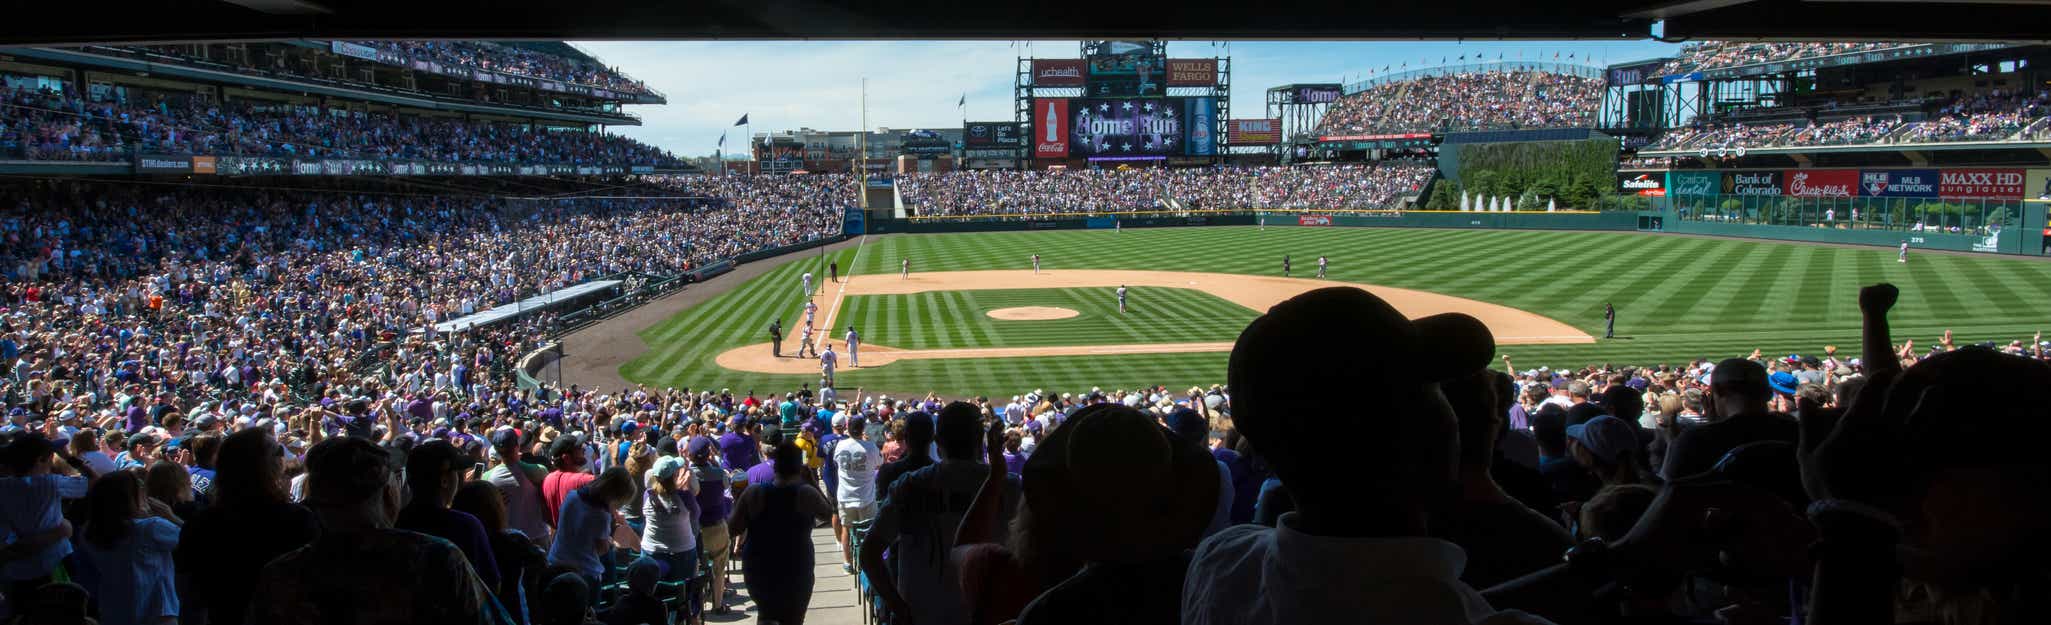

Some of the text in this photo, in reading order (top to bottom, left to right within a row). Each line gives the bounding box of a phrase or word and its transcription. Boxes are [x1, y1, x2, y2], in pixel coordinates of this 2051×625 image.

[1040, 66, 1080, 77] uchealth
[1172, 63, 1211, 72] WELLS
[1173, 72, 1211, 81] FARGO
[1610, 69, 1640, 85] Run
[1076, 115, 1178, 136] Home Run
[1623, 179, 1660, 189] Safelite
[1735, 173, 1774, 185] Bank of
[1901, 176, 1921, 185] MLB
[1940, 172, 2023, 185] MAXX HD
[1735, 184, 1782, 196] Colorado
[1888, 184, 1932, 192] NETWORK
